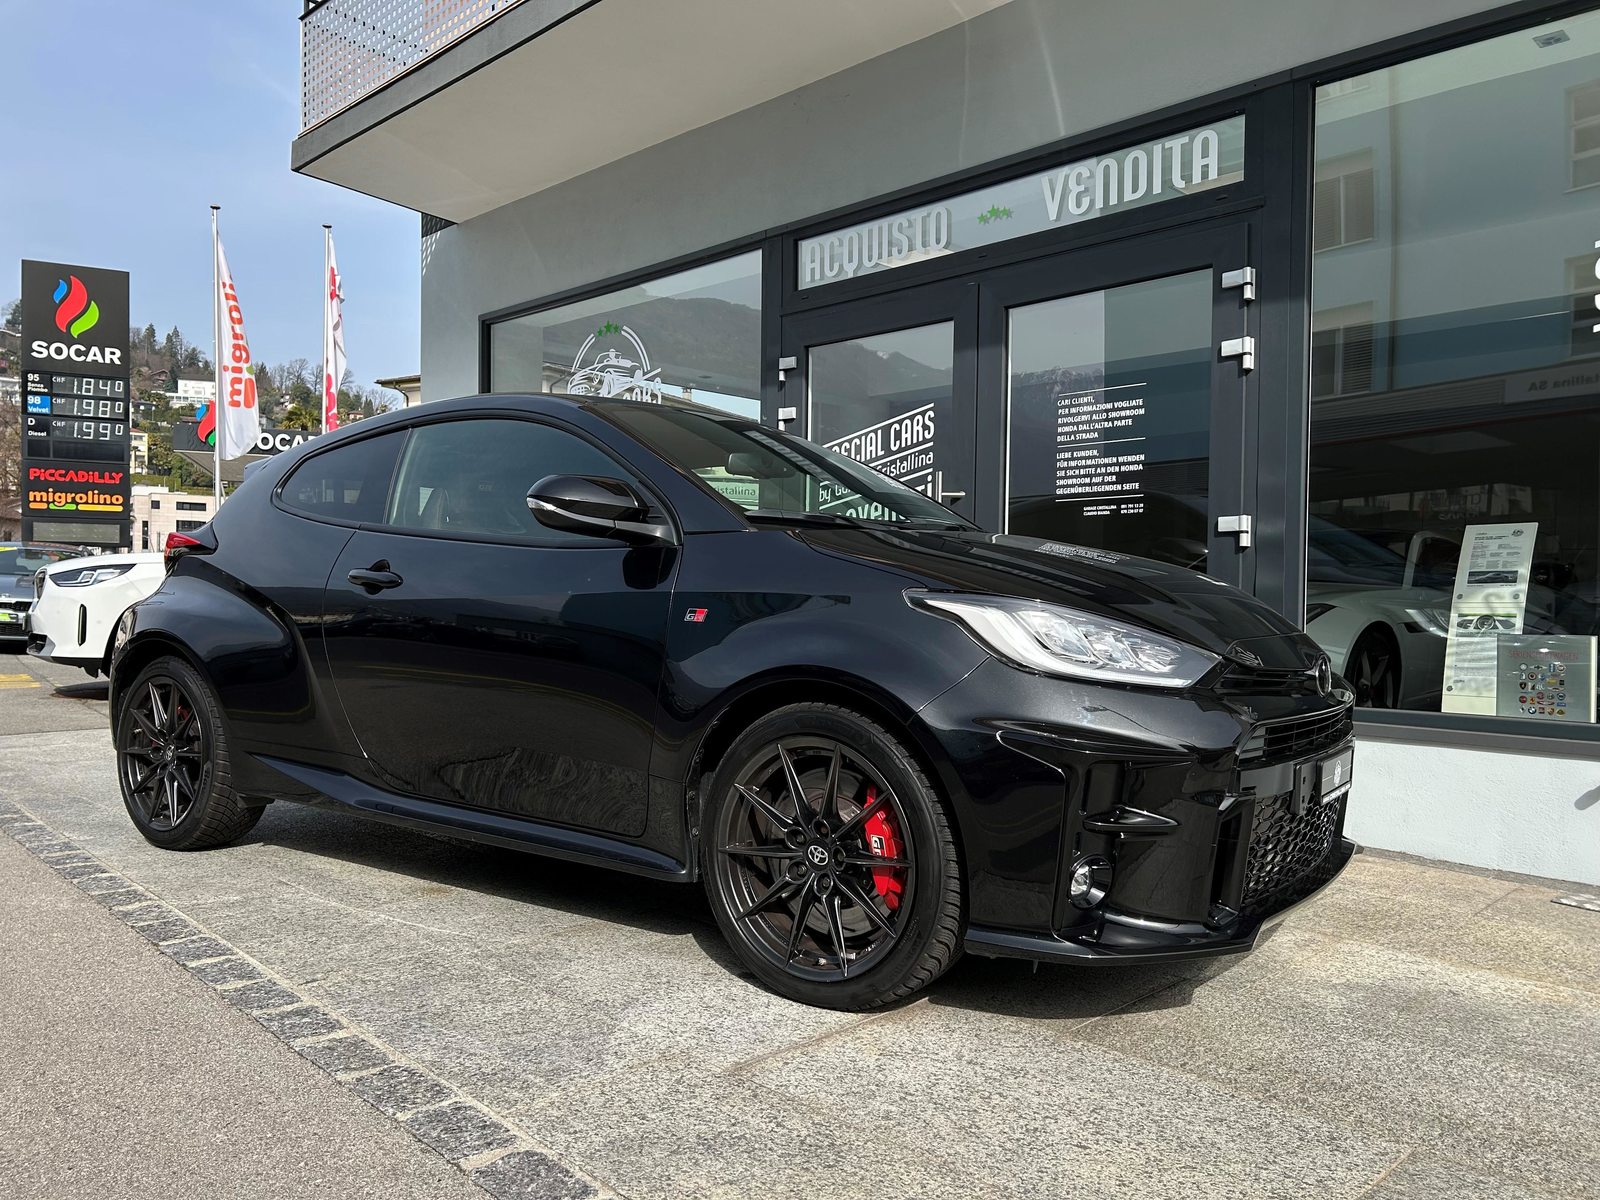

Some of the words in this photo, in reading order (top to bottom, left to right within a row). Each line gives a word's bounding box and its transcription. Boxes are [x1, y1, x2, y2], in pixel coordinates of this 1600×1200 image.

[805, 206, 949, 283] ACQUISTO
[1040, 129, 1219, 222] VENDITA
[223, 280, 251, 408] migroli
[31, 340, 122, 365] SOCAR
[27, 373, 40, 382] 95
[27, 395, 41, 405] 98
[1058, 398, 1071, 406] CARI
[1072, 396, 1095, 405] CLIENTI,
[1070, 403, 1113, 414] INFORMAZIONI
[1114, 399, 1143, 408] VOGLIATE
[27, 418, 36, 426] D
[1058, 414, 1091, 424] RIVOLGERVI
[1108, 408, 1145, 418] SHOWROOM
[890, 410, 935, 452] CARS
[1058, 424, 1077, 433] HONDA
[1114, 419, 1133, 427] PARTE
[257, 432, 318, 451] OCA
[1057, 433, 1075, 442] DELLA
[1076, 432, 1099, 441] STRADA
[1073, 449, 1099, 458] KUNDEN,
[1056, 460, 1067, 468] FÜR
[1068, 456, 1117, 467] INFORMATIONEN
[1118, 454, 1145, 463] WENDEN
[1080, 467, 1096, 475] BITTE
[1107, 465, 1119, 473] DEN
[1120, 464, 1143, 472] HONDA
[819, 486, 832, 503] by
[876, 451, 934, 477] ristallina
[1056, 477, 1091, 486] SHOWROOM
[1056, 484, 1122, 495] GEGENÜBERLIEGENDEN
[1122, 482, 1140, 490] SEITE
[29, 488, 123, 507] migrolino
